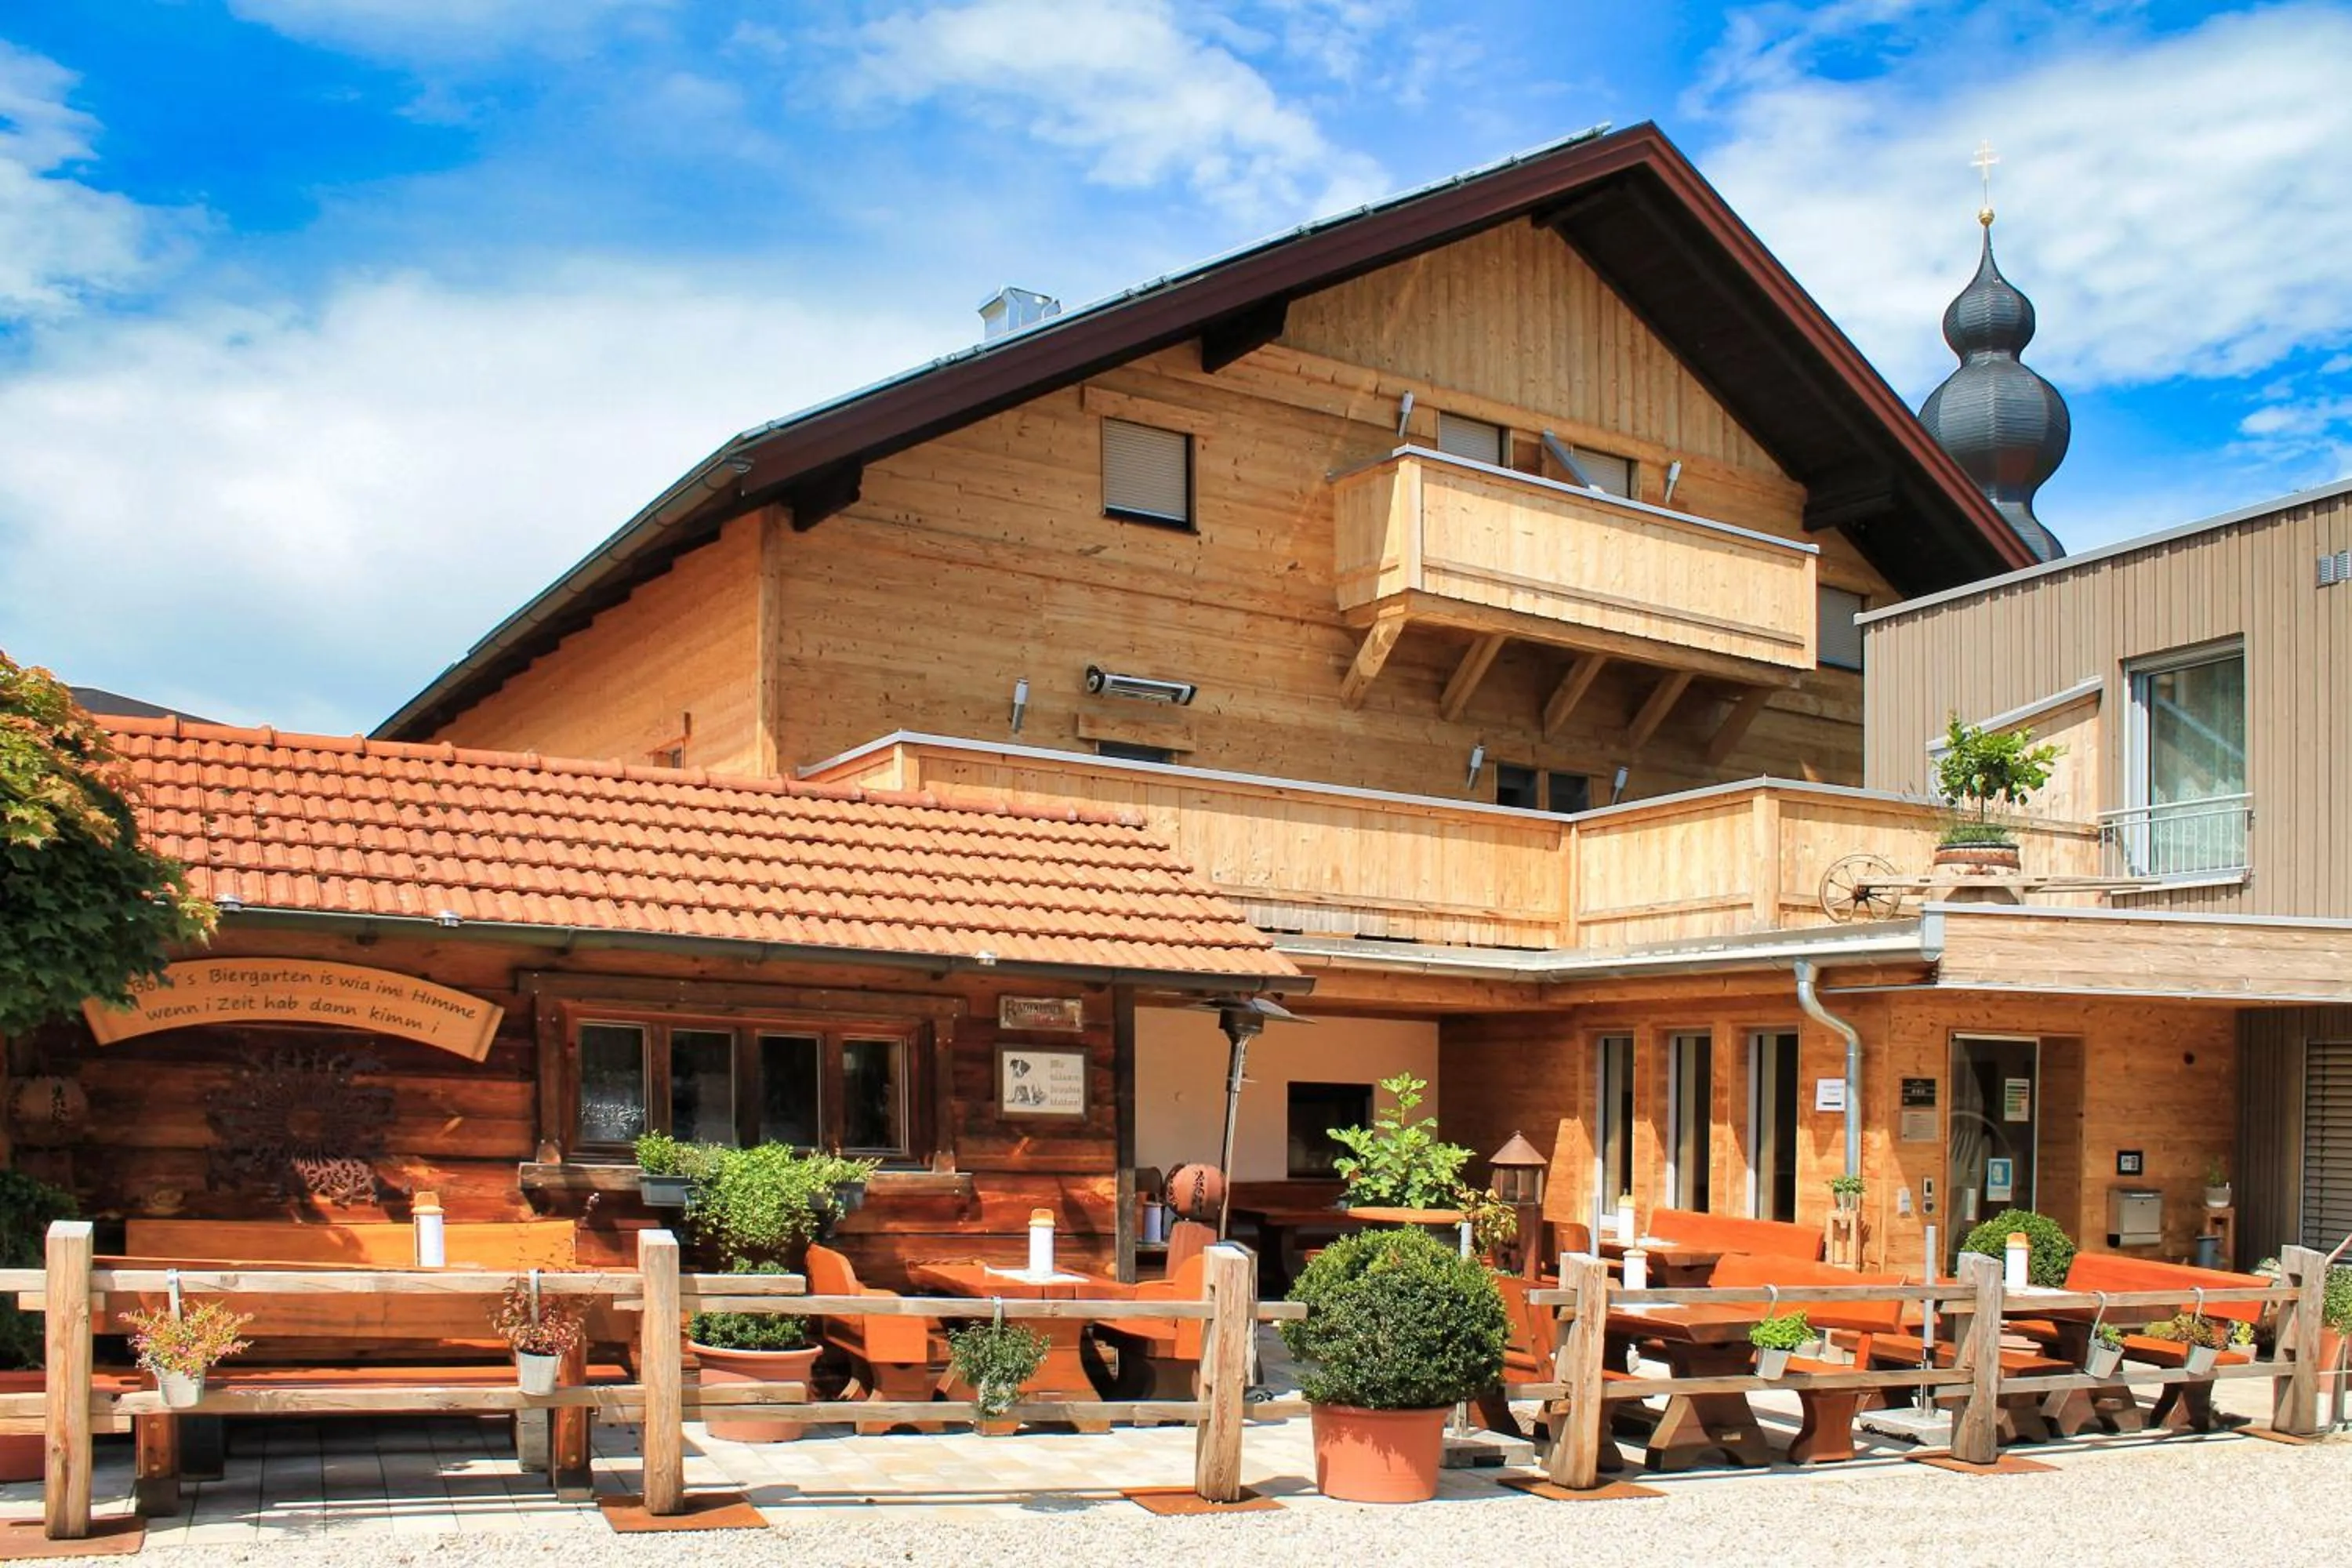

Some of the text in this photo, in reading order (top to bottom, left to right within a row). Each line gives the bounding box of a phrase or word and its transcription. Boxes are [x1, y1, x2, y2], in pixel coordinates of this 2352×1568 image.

[146, 994, 441, 1035] wenn i Zeit hab dann kimm i
[209, 968, 312, 987] Biergarten
[320, 970, 333, 985] is
[339, 975, 370, 990] wia
[411, 989, 477, 1018] Himme
